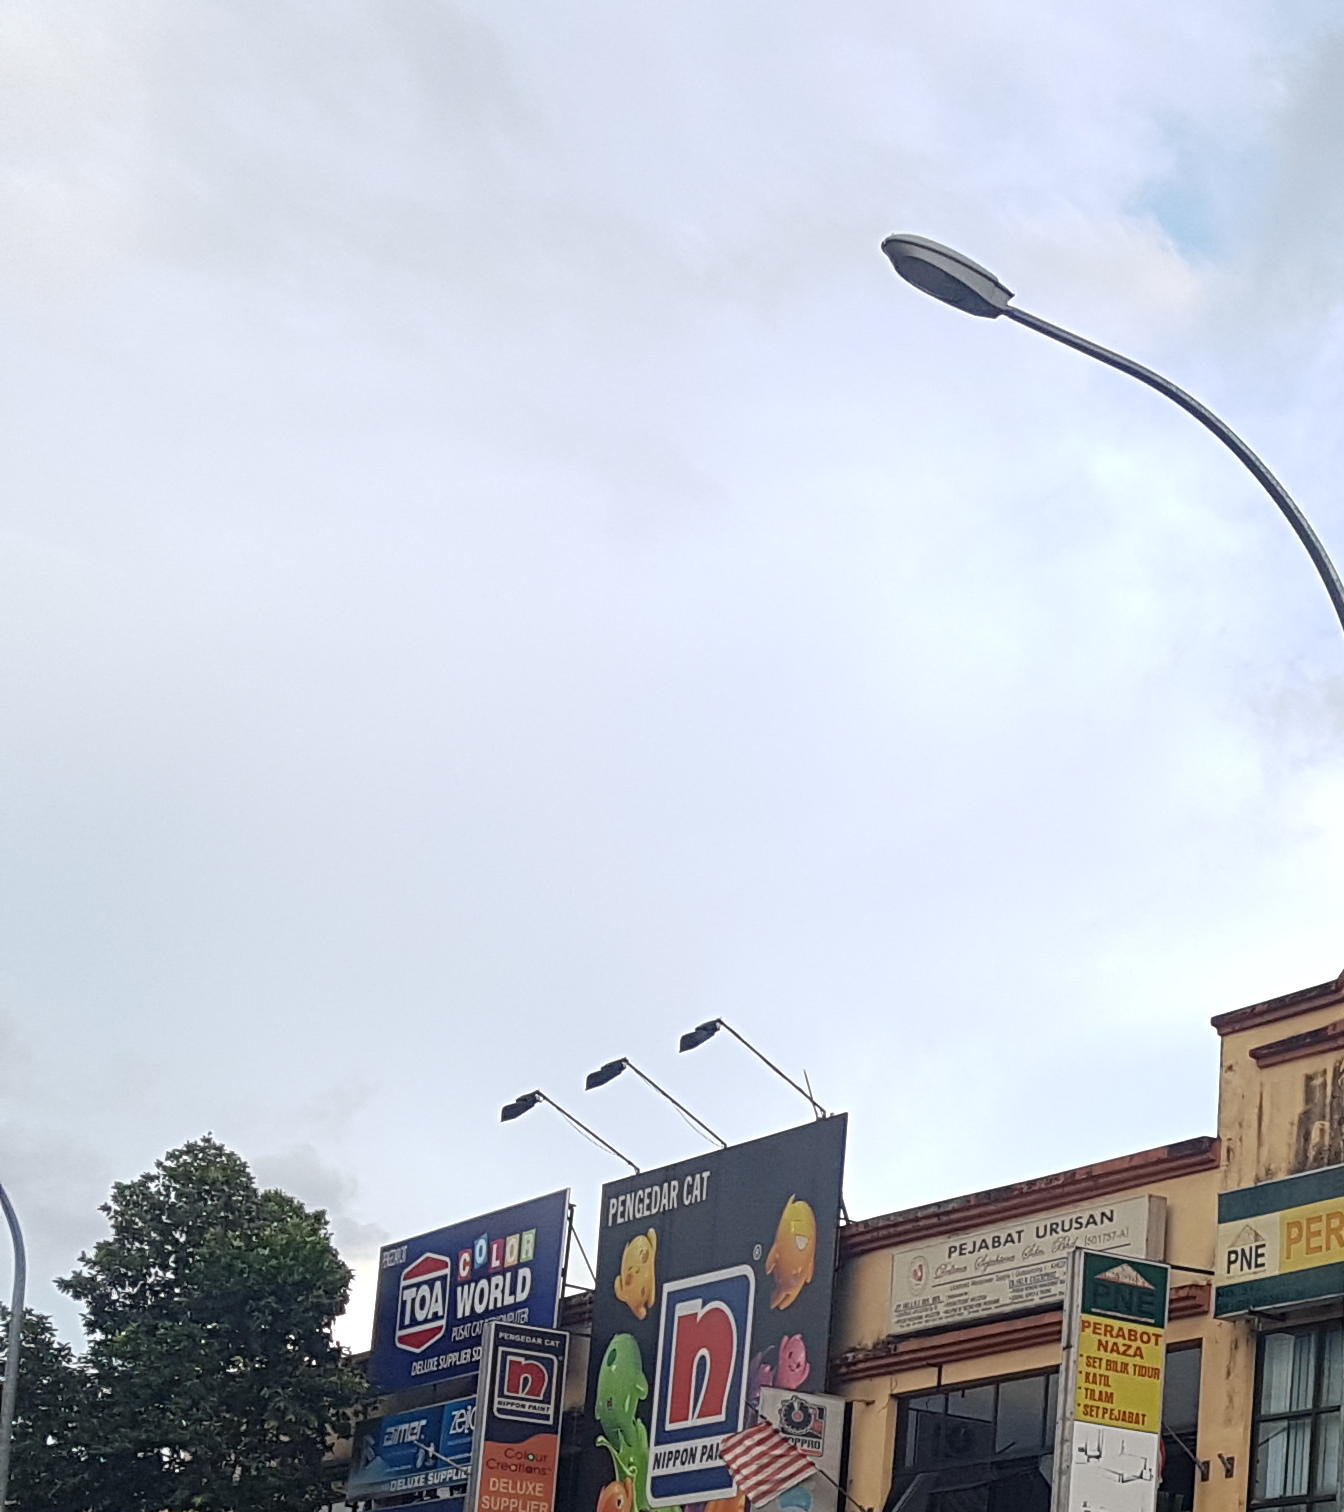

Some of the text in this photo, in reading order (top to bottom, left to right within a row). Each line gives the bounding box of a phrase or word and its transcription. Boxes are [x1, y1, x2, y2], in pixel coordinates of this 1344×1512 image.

[608, 1170, 711, 1226] PENGEDAR CAT
[948, 1209, 1114, 1259] PEJABAT URUSAN
[458, 1230, 536, 1280] COLOR
[1227, 1244, 1266, 1274] PNE
[402, 1281, 443, 1325] TOA
[457, 1267, 532, 1319] WORLD
[1081, 1319, 1163, 1347] PERABOT
[1097, 1338, 1144, 1360] NAZA
[411, 1356, 440, 1376] DELUXE
[1086, 1355, 1160, 1380] SET BILIK TIDUR
[1085, 1371, 1112, 1388] KATIL
[1084, 1387, 1114, 1405] TILAM
[1083, 1403, 1147, 1427] SET PEJABAT
[504, 1448, 547, 1462] Colour
[653, 1447, 696, 1471] NIPPON
[486, 1460, 548, 1475] Creations
[390, 1472, 425, 1492] DELUXE
[489, 1478, 544, 1496] DELUXE
